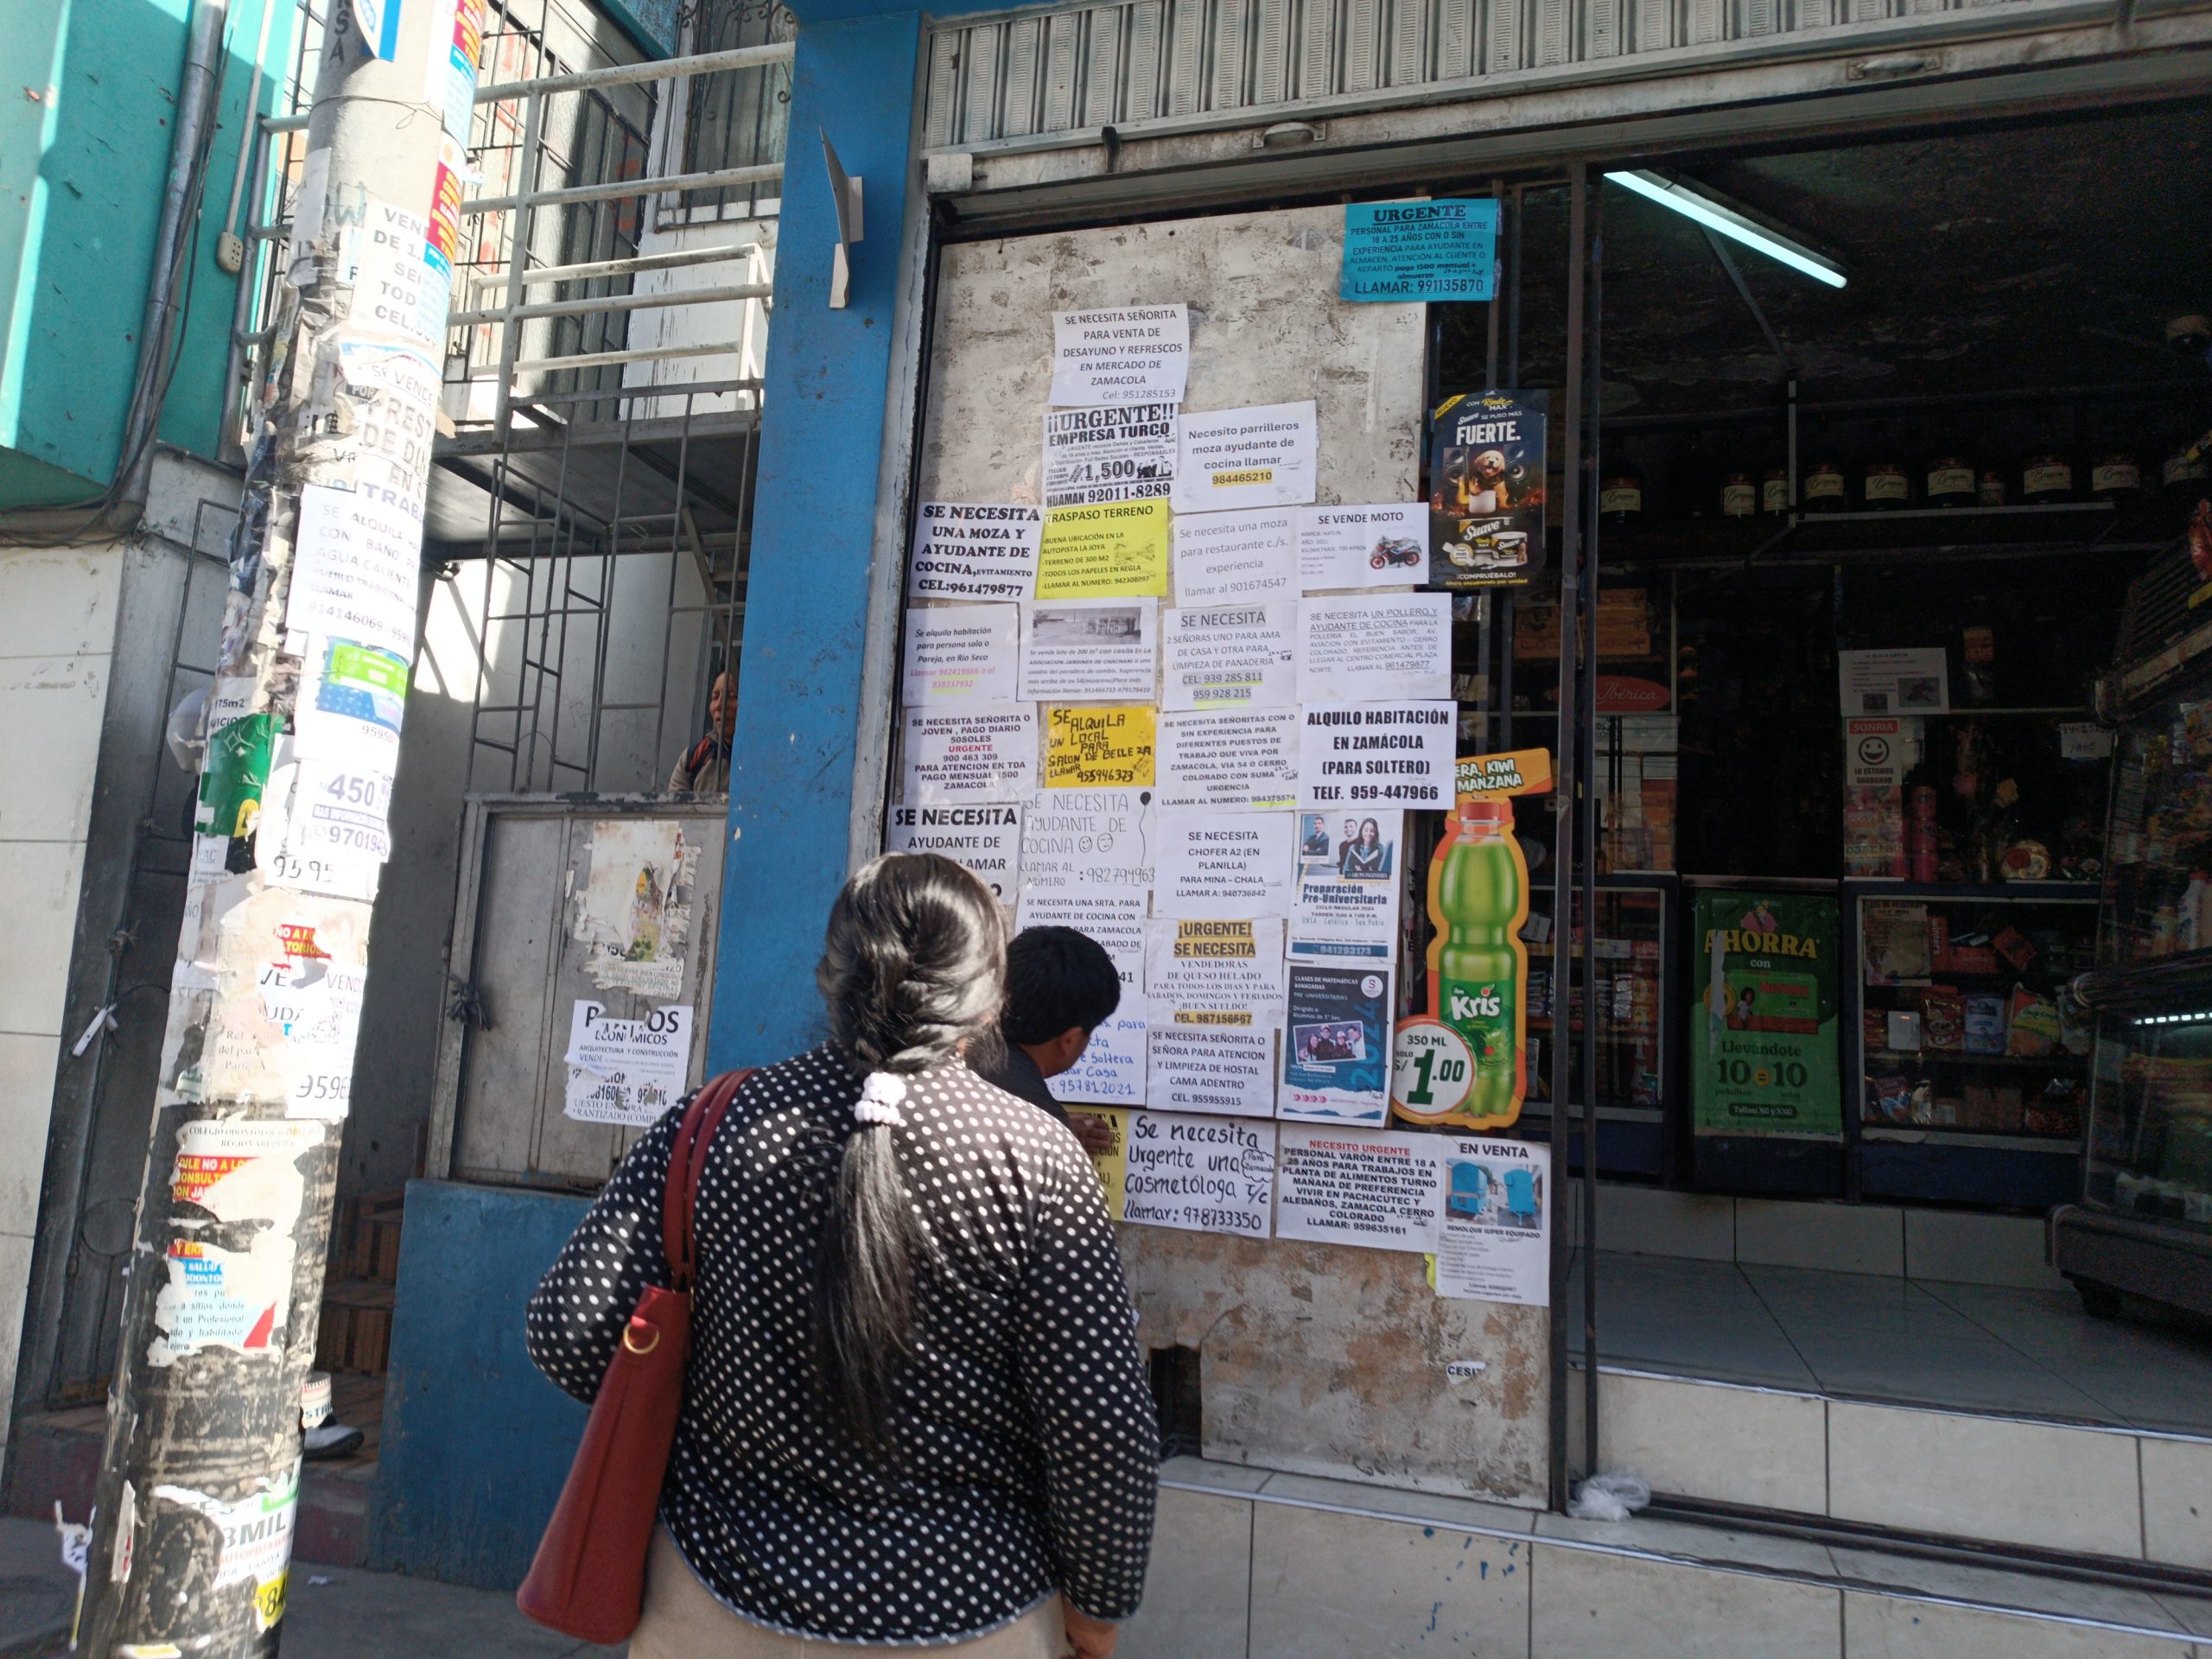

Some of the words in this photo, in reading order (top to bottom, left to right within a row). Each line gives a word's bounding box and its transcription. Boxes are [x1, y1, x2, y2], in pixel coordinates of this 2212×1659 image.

[1373, 205, 1465, 222] URGENTE
[373, 229, 402, 251] DE
[1401, 232, 1422, 242] AÑOS
[1425, 232, 1441, 240] CON
[1355, 282, 1414, 294] LLAMAR:
[1418, 279, 1484, 292] 991135870
[1065, 316, 1077, 325] SE
[1079, 313, 1125, 324] NECESITA
[1128, 309, 1177, 321] SEÑORITA
[1063, 346, 1116, 358] DESAYUNO
[1118, 346, 1126, 355] Y
[1128, 343, 1182, 354] REFRESCOS
[1090, 376, 1147, 386] ZAMACOLA
[1103, 391, 1120, 400] Cel:
[1122, 389, 1176, 399] 951285153
[1436, 397, 1459, 416] NUEVO
[1048, 403, 1174, 433] ¡¡URGENTE!!
[1458, 413, 1480, 425] Suave
[1049, 429, 1116, 447] EMPRESA
[1119, 422, 1170, 438] TURCO
[1188, 427, 1237, 439] Necesito
[1240, 423, 1300, 436] parrilleros
[1456, 421, 1522, 446] FUERTE.
[1192, 445, 1222, 454] moza
[1224, 439, 1277, 454] ayudante
[1281, 438, 1294, 448] de
[1205, 458, 1242, 469] cocina
[1244, 456, 1281, 467] llamar
[1085, 460, 1136, 482] 1,500
[1212, 472, 1272, 484] 984465210
[1046, 492, 1084, 508] HUAMAN
[1088, 483, 1171, 503] 92011-8289
[924, 505, 945, 518] SE
[950, 506, 1040, 521] NECESITA
[1046, 510, 1101, 523] TRASPASO
[1103, 505, 1154, 518] TERRENO
[1318, 515, 1330, 524] SE
[1332, 514, 1368, 524] VENDE
[1370, 512, 1404, 522] MOTO
[319, 525, 352, 543] CON
[351, 512, 403, 541] ALQUILA
[932, 526, 965, 538] UNA
[969, 528, 1010, 539] MOZA
[1015, 529, 1026, 539] Y
[1463, 520, 1500, 541] Suave
[921, 543, 1006, 557] AYUDANTE
[1009, 547, 1030, 557] DE
[918, 579, 1023, 596] CEL:961479877
[1185, 585, 1216, 597] llamar
[1218, 583, 1228, 594] al
[1230, 577, 1287, 592] 901674547
[1310, 613, 1321, 621] SE
[1325, 611, 1368, 620] NECESITA
[1370, 610, 1383, 619] UN
[1387, 608, 1428, 617] POLLERO
[1193, 690, 1211, 700] 959
[1212, 689, 1230, 698] 928
[1234, 688, 1251, 697] 215
[1598, 681, 1658, 702] Ibérica
[1052, 709, 1071, 726] SE
[1070, 714, 1125, 733] ALQUILA
[1307, 711, 1362, 727] ALQUILO
[1365, 709, 1449, 725] HABITACIÓN
[1853, 722, 1894, 732] SONRIA
[1050, 738, 1065, 748] UN
[1071, 729, 1109, 746] LOCAL
[1333, 736, 1349, 750] EN
[1352, 733, 1424, 749] ZAMÁCOLA
[1080, 741, 1109, 753] PARA
[1050, 764, 1081, 778] LLAMAR
[1322, 761, 1362, 775] (PARA
[1366, 760, 1430, 775] SOLTERO)
[1486, 759, 1515, 774] KIWI
[327, 774, 375, 807] 450
[1457, 773, 1522, 792] MANZANA
[1313, 786, 1344, 800] TELF.
[1351, 785, 1439, 800] 959-447966
[895, 809, 916, 826] SE
[922, 808, 1017, 826] NECESITA
[908, 836, 979, 849] AYUDANTE
[983, 836, 1001, 849] DE
[1188, 831, 1202, 841] SE
[1205, 831, 1258, 841] NECESITA
[1188, 848, 1228, 856] CHOFER
[1243, 848, 1260, 857] (EN
[1198, 861, 1246, 871] PLANILLA)
[1304, 883, 1363, 894] Preparación
[1303, 893, 1387, 905] Pre-Universitaria
[1179, 922, 1252, 938] ¡URGENTE!
[1173, 943, 1191, 956] SE
[1193, 942, 1255, 956] NECESITA
[1750, 958, 1771, 969] con
[1451, 994, 1501, 1021] Kris
[1174, 1014, 1194, 1023] CEL.
[1196, 1014, 1252, 1025] 987156567
[1152, 1031, 1162, 1040] SE
[1165, 1032, 1208, 1042] NECESITA
[1210, 1033, 1255, 1045] SEÑORITA
[1258, 1037, 1265, 1046] O
[1407, 1035, 1427, 1046] 350
[1431, 1037, 1447, 1046] ML
[1722, 1040, 1802, 1058] Llevándote
[580, 1053, 603, 1062] VENDE
[1091, 1053, 1134, 1065] Soltera
[1086, 1066, 1117, 1077] Casa
[1717, 1058, 1752, 1085] 10
[1772, 1062, 1808, 1088] 10
[1135, 1115, 1159, 1140] Se
[1171, 1123, 1259, 1149] necesita
[1309, 1140, 1359, 1152] NECESITO
[1363, 1144, 1411, 1156] URGENTE
[1459, 1142, 1478, 1154] EN
[1483, 1145, 1529, 1159] VENTA
[202, 1159, 218, 1170] NO
[220, 1159, 228, 1170] A
[1128, 1145, 1195, 1173] Urgente
[1209, 1154, 1240, 1173] una
[1125, 1173, 1237, 1204] Cosmetóloga
[1123, 1199, 1179, 1223] llamar:
[1306, 1217, 1351, 1230] LLAMAR:
[1353, 1222, 1407, 1236] 959635161
